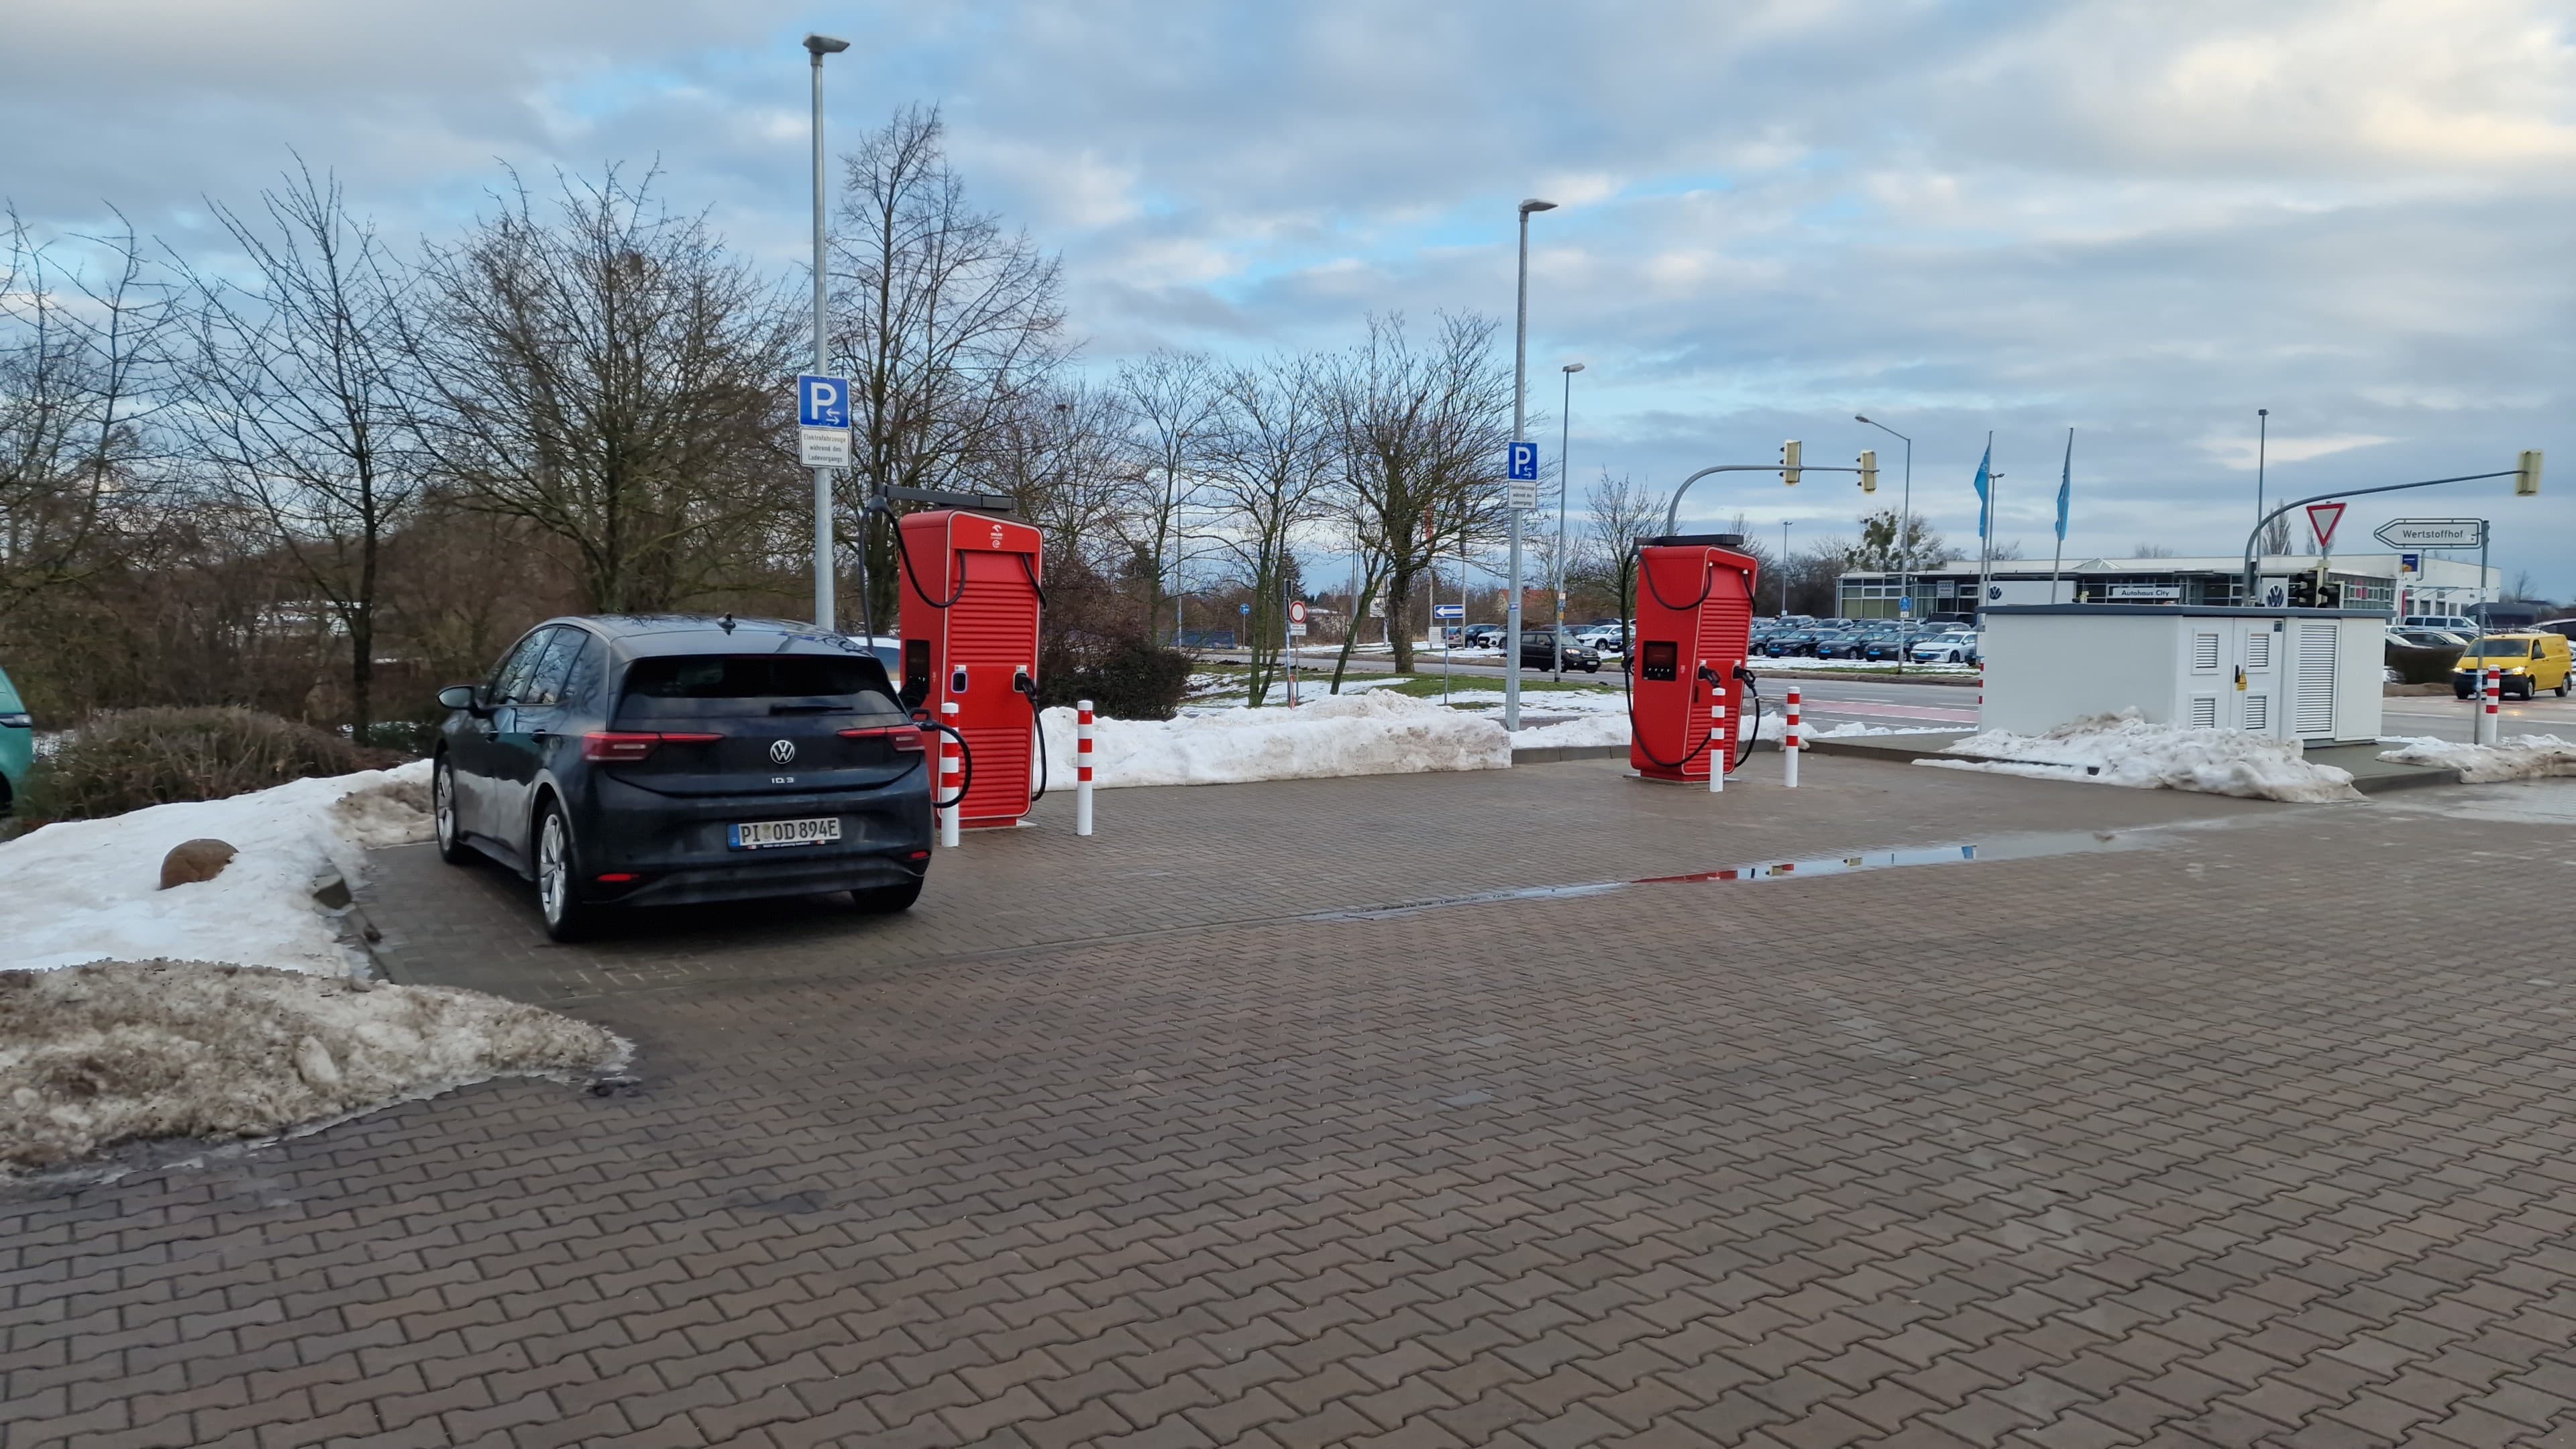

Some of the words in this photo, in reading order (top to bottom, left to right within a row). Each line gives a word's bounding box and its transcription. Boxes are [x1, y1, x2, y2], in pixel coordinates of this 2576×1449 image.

[810, 382, 837, 420] P
[1515, 446, 1531, 475] P
[2403, 529, 2464, 538] Wertstoffhof
[740, 824, 760, 843] PI
[773, 823, 795, 841] OD
[799, 820, 838, 839] 894E
